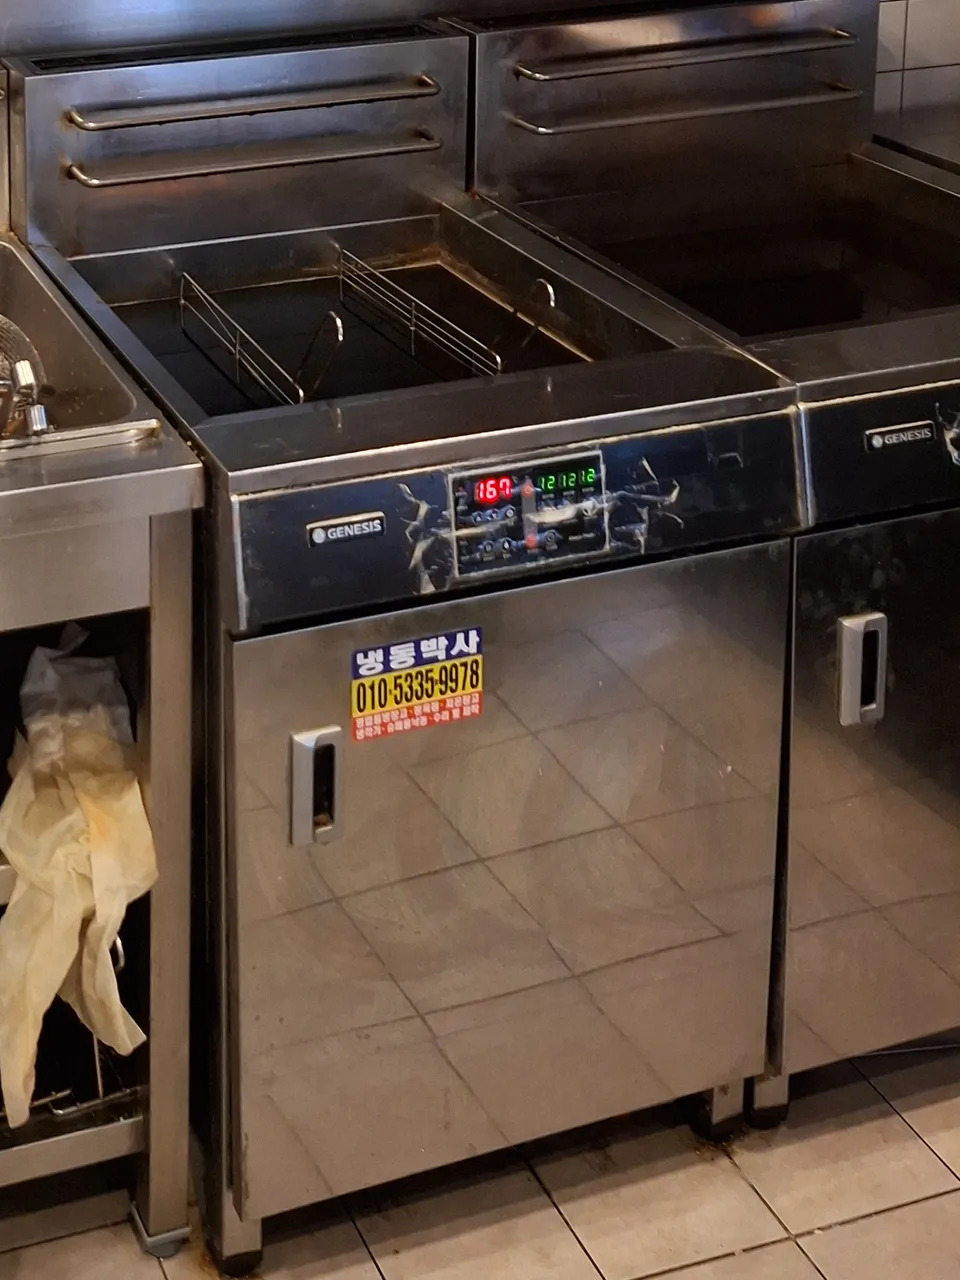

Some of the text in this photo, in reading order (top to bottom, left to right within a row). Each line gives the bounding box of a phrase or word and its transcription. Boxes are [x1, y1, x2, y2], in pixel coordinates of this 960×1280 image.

[884, 427, 932, 444] GENESIS
[326, 519, 382, 540] GENESIS
[356, 629, 480, 677] 냉동박사
